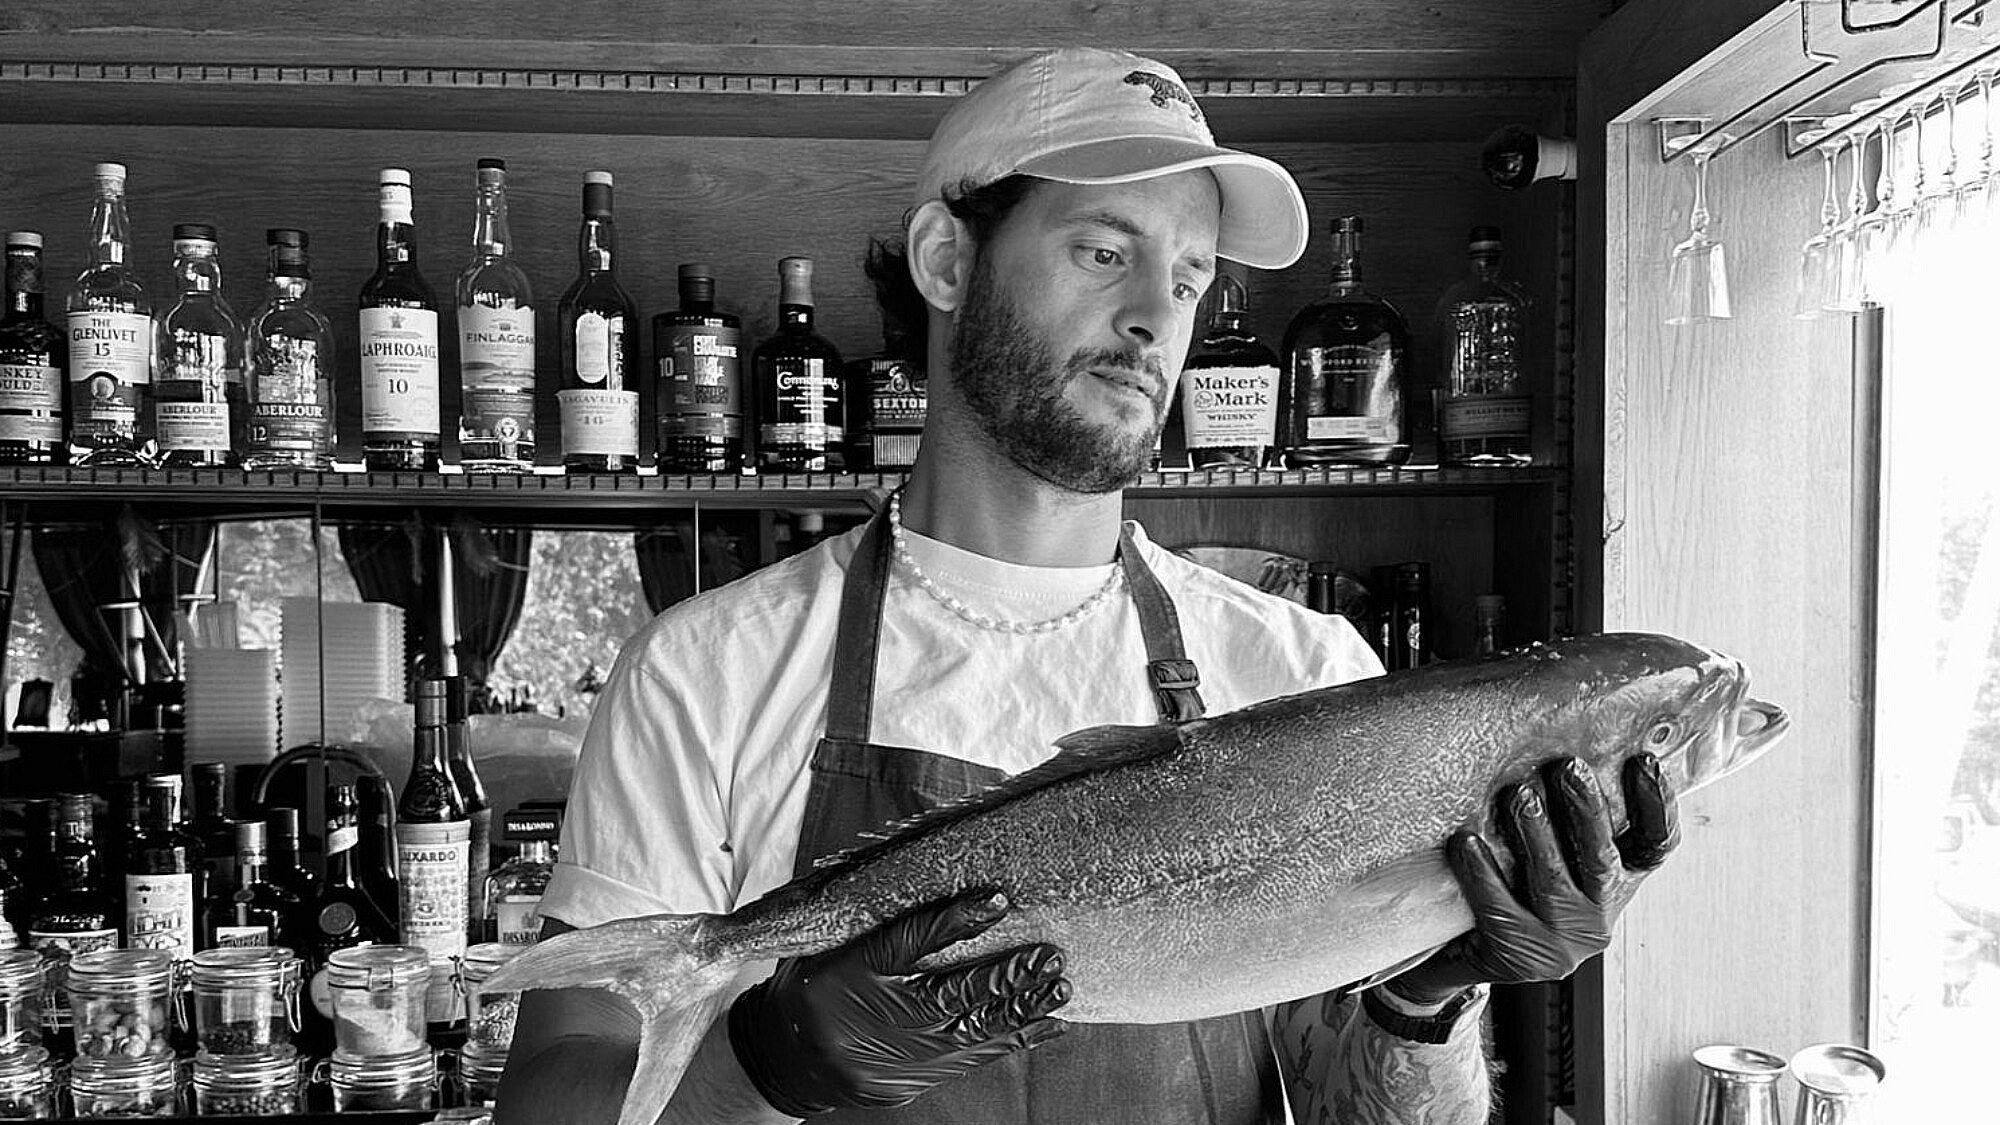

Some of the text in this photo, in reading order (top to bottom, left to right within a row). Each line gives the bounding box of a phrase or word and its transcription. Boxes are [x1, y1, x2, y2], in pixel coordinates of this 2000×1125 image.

[91, 318, 112, 328] THE
[73, 327, 137, 343] GLENLIVET
[95, 342, 111, 357] 15
[361, 342, 437, 359] LAPHROAIG
[659, 356, 674, 378] 10
[389, 378, 409, 395] 10
[1194, 375, 1270, 390] Maker's
[1214, 391, 1269, 407] Mark
[255, 404, 323, 418] ABERLOUR
[1206, 413, 1258, 421] WHISKY
[253, 425, 267, 442] 12
